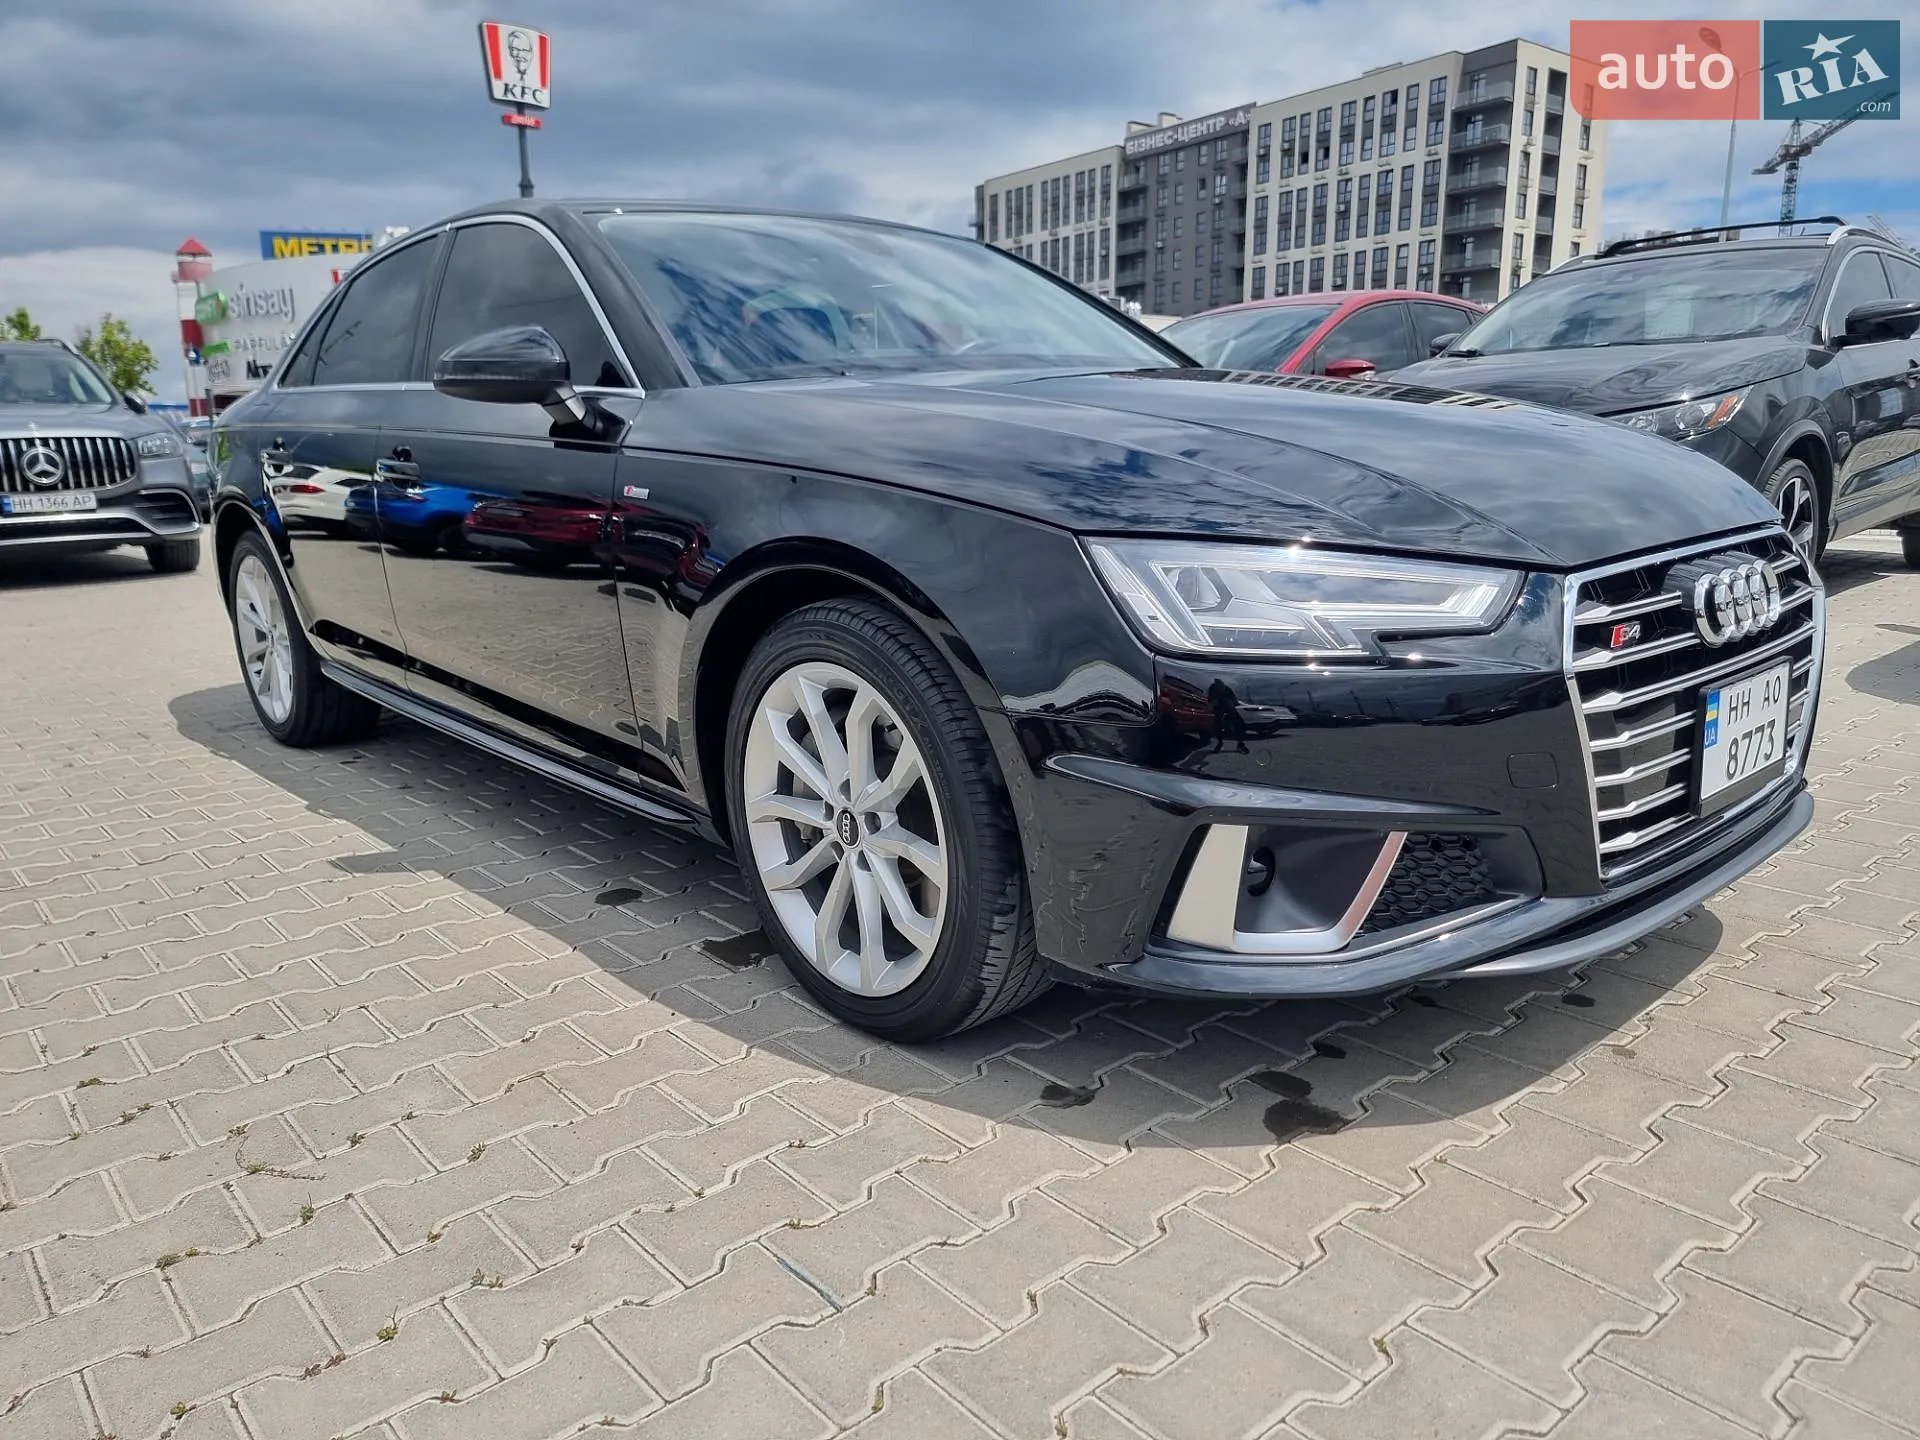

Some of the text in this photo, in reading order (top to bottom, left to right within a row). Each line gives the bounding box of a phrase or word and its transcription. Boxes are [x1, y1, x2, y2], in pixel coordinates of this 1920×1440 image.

[502, 83, 545, 104] KFC
[229, 282, 296, 324] sinsay
[39, 495, 69, 510] 1366
[1727, 687, 1751, 727] HH
[1704, 730, 1716, 746] UA
[1726, 717, 1776, 781] 8773
